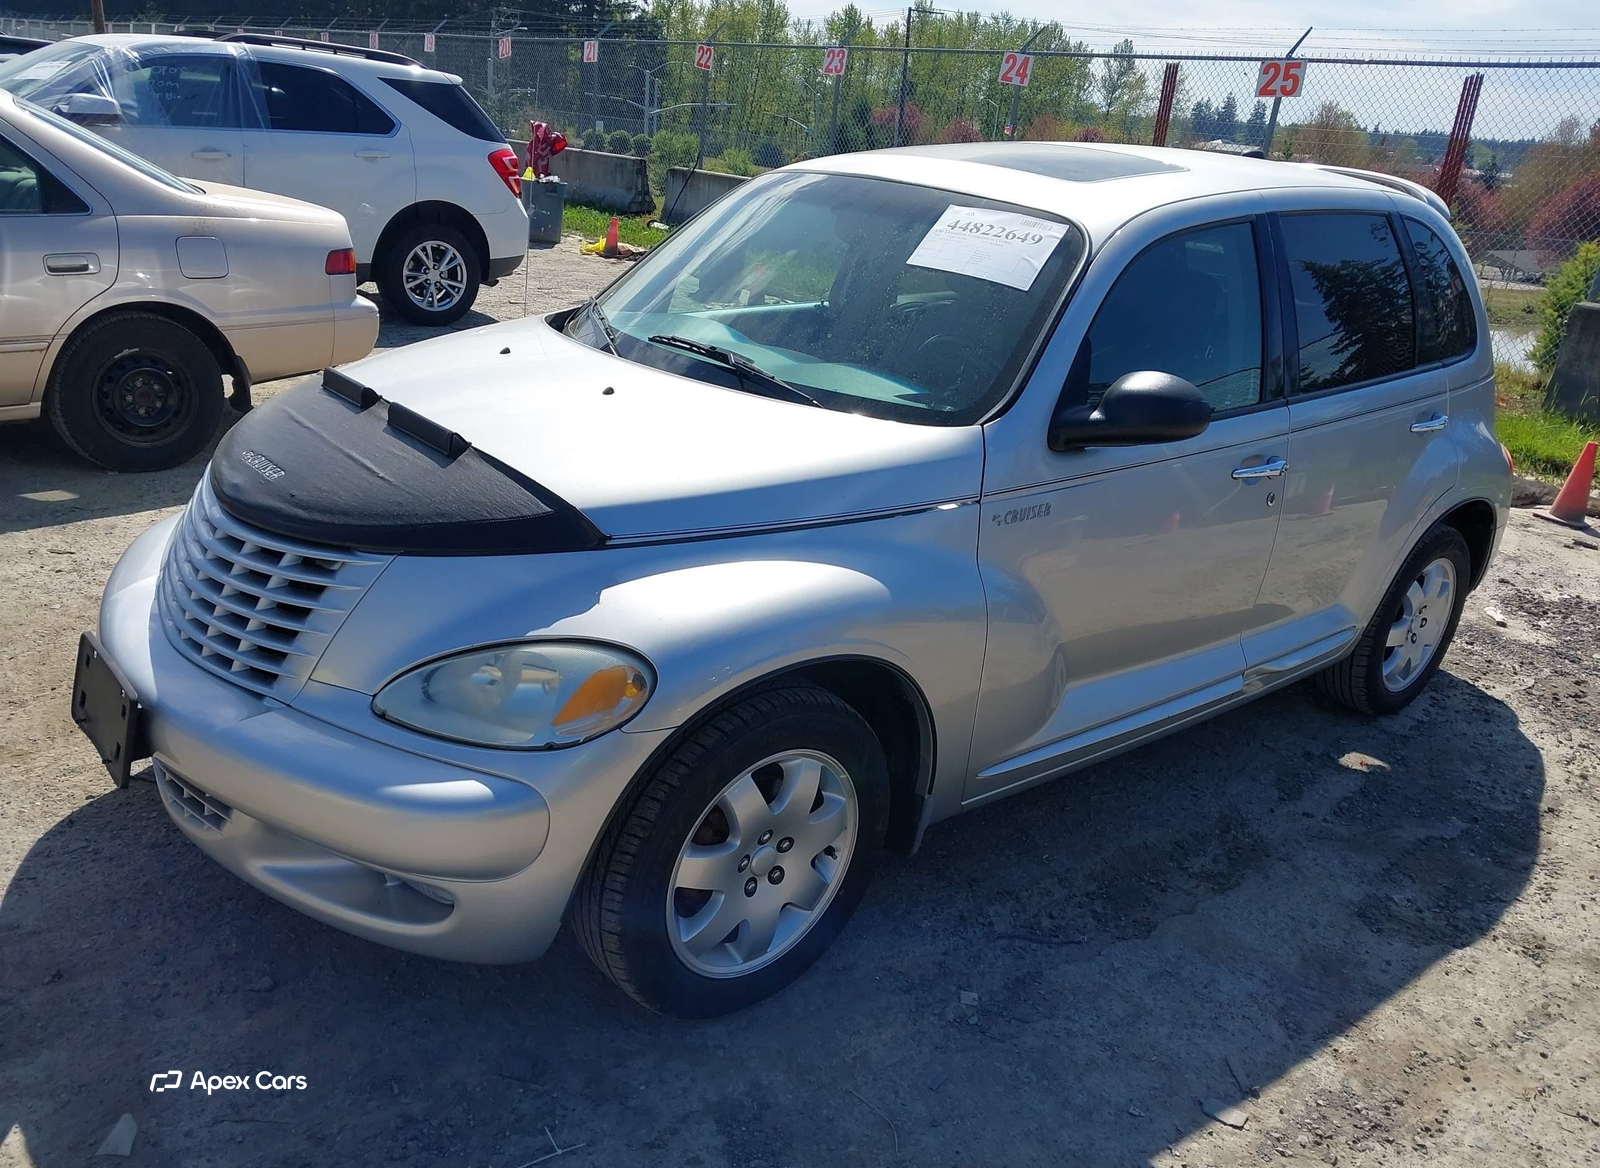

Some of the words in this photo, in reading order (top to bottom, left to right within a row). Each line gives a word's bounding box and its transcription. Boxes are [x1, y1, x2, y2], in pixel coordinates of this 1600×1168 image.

[426, 35, 433, 50] 19
[500, 39, 510, 58] 20
[586, 41, 596, 61] 21
[696, 45, 712, 69] 22
[824, 49, 846, 74] 23
[1000, 54, 1030, 84] 24
[1259, 62, 1302, 96] 25
[946, 219, 1044, 246] 44822649
[248, 455, 285, 480] CRUISER
[1004, 502, 1052, 525] CRUISER
